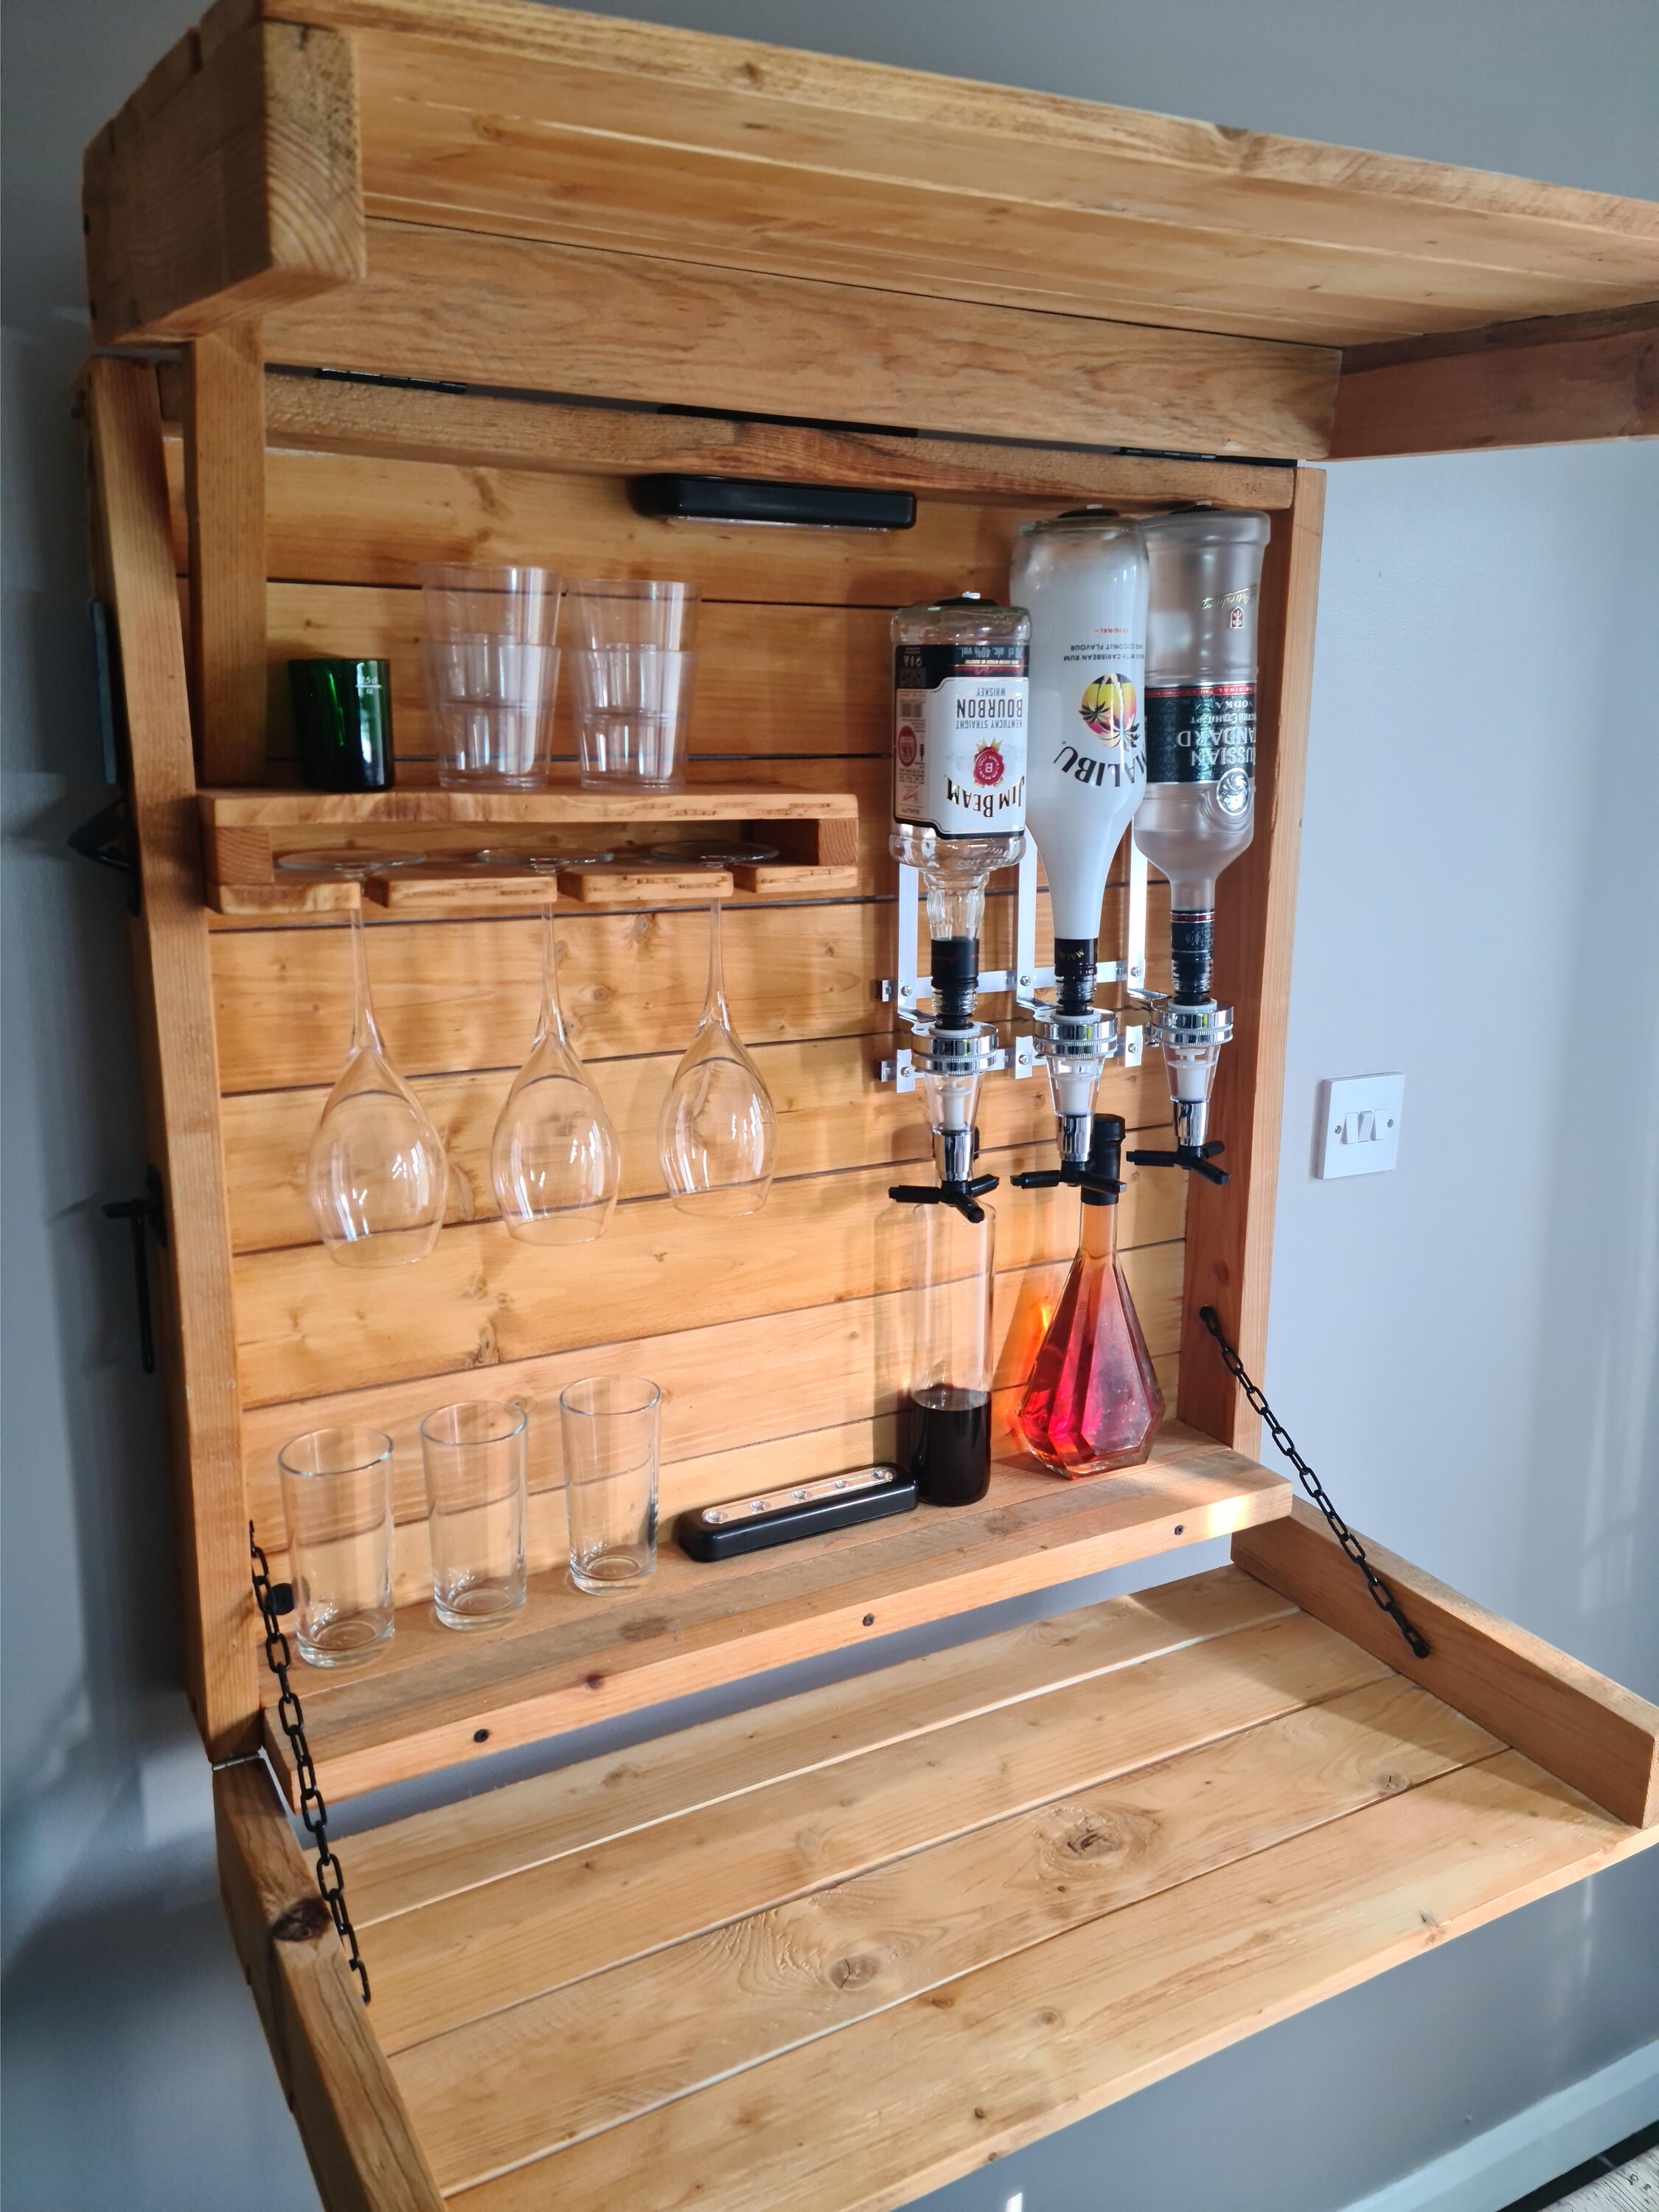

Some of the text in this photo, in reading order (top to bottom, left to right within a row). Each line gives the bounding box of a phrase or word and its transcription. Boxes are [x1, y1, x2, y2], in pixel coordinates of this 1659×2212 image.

[974, 647, 990, 658] 40%
[1015, 647, 1023, 658] 70
[976, 687, 1006, 696] WHISKEY
[956, 699, 1023, 718] BOURBON
[1214, 700, 1253, 709] VODKA
[956, 719, 1022, 729] KENTUCKY STRAIGHT
[985, 762, 993, 773] B
[1053, 745, 1147, 787] MALIBU
[946, 777, 994, 818] BEAM
[999, 775, 1024, 810] JIM
